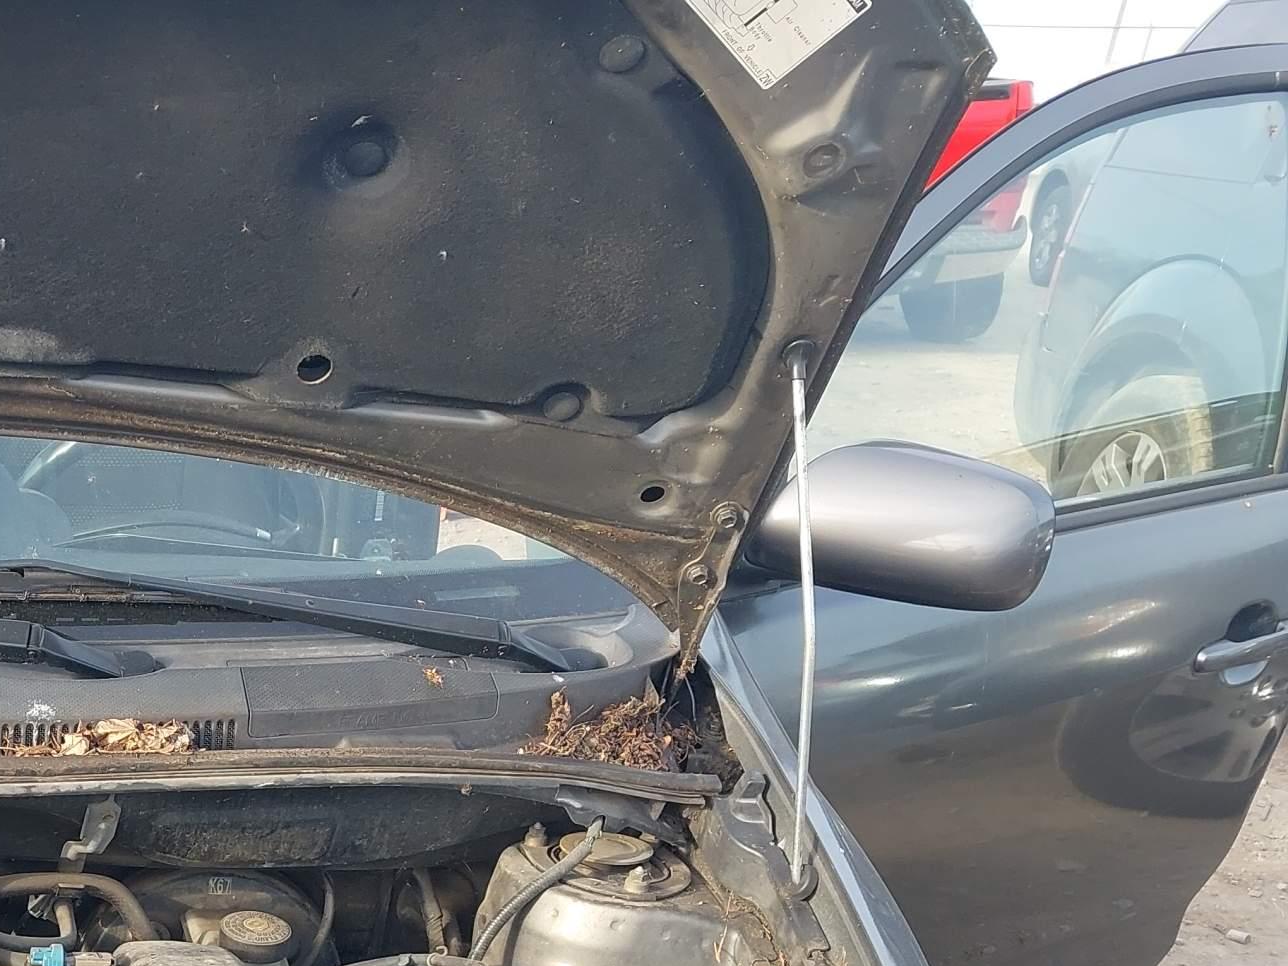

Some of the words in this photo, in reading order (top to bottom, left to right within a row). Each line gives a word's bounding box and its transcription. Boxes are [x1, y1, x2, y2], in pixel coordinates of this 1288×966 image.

[755, 22, 772, 42] Throttle
[722, 29, 738, 46] FRONT
[736, 46, 745, 54] OF
[744, 54, 763, 75] VEHICLE
[208, 877, 231, 894] K67
